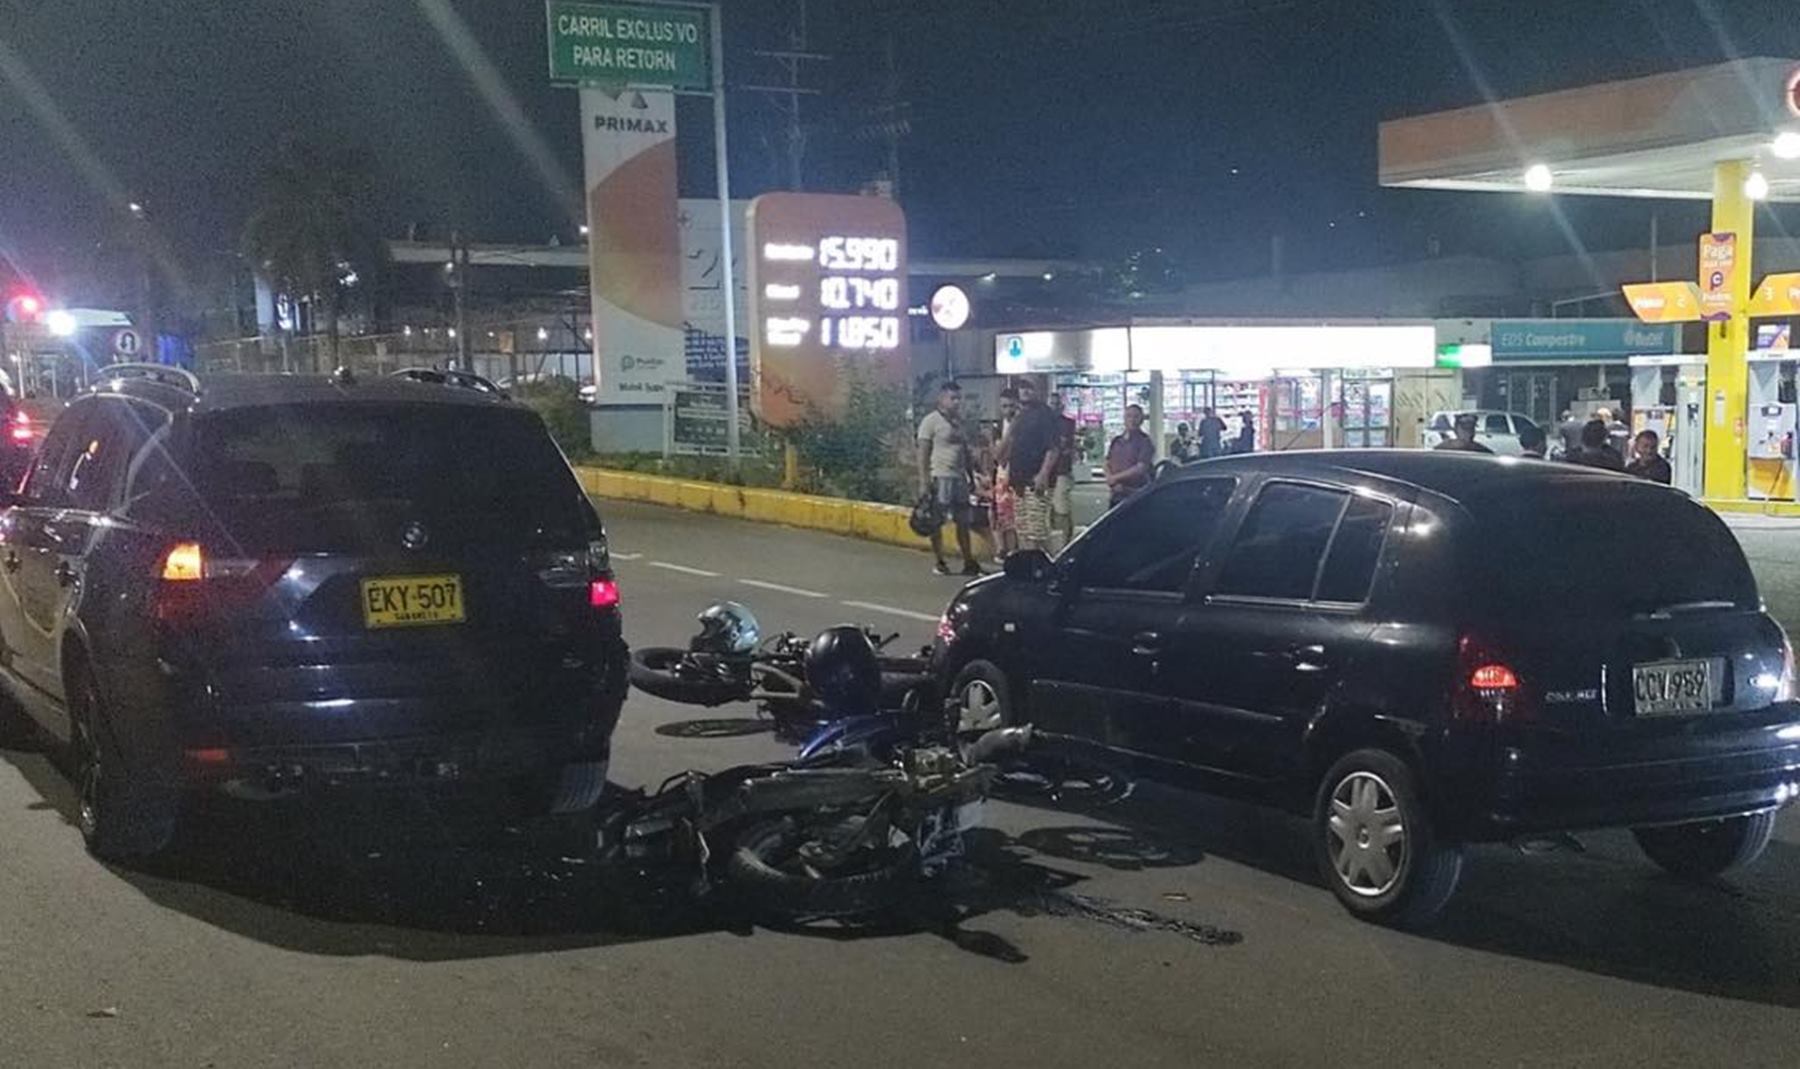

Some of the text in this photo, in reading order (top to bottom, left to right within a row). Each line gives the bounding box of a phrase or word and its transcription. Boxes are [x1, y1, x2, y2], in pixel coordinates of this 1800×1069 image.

[558, 15, 614, 38] CARRIL
[573, 45, 614, 68] PARA
[594, 115, 669, 134] PRIMAX
